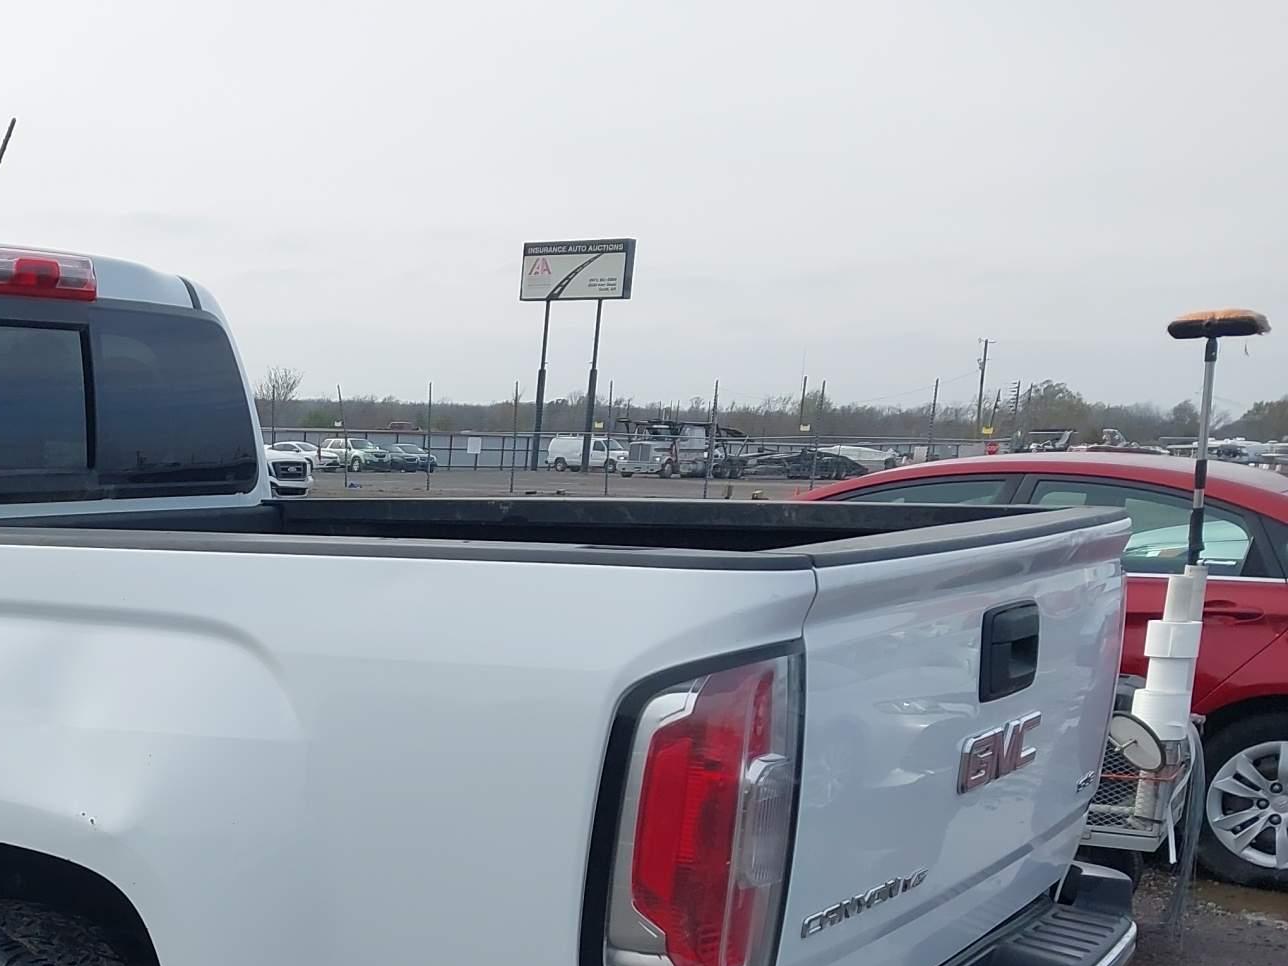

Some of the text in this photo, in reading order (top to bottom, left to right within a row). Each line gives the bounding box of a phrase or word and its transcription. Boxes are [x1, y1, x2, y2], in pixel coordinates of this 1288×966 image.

[527, 243, 624, 255] INSURANCE AUTO AUCTIONS
[957, 711, 1042, 795] GMC
[800, 876, 902, 940] CANYON
